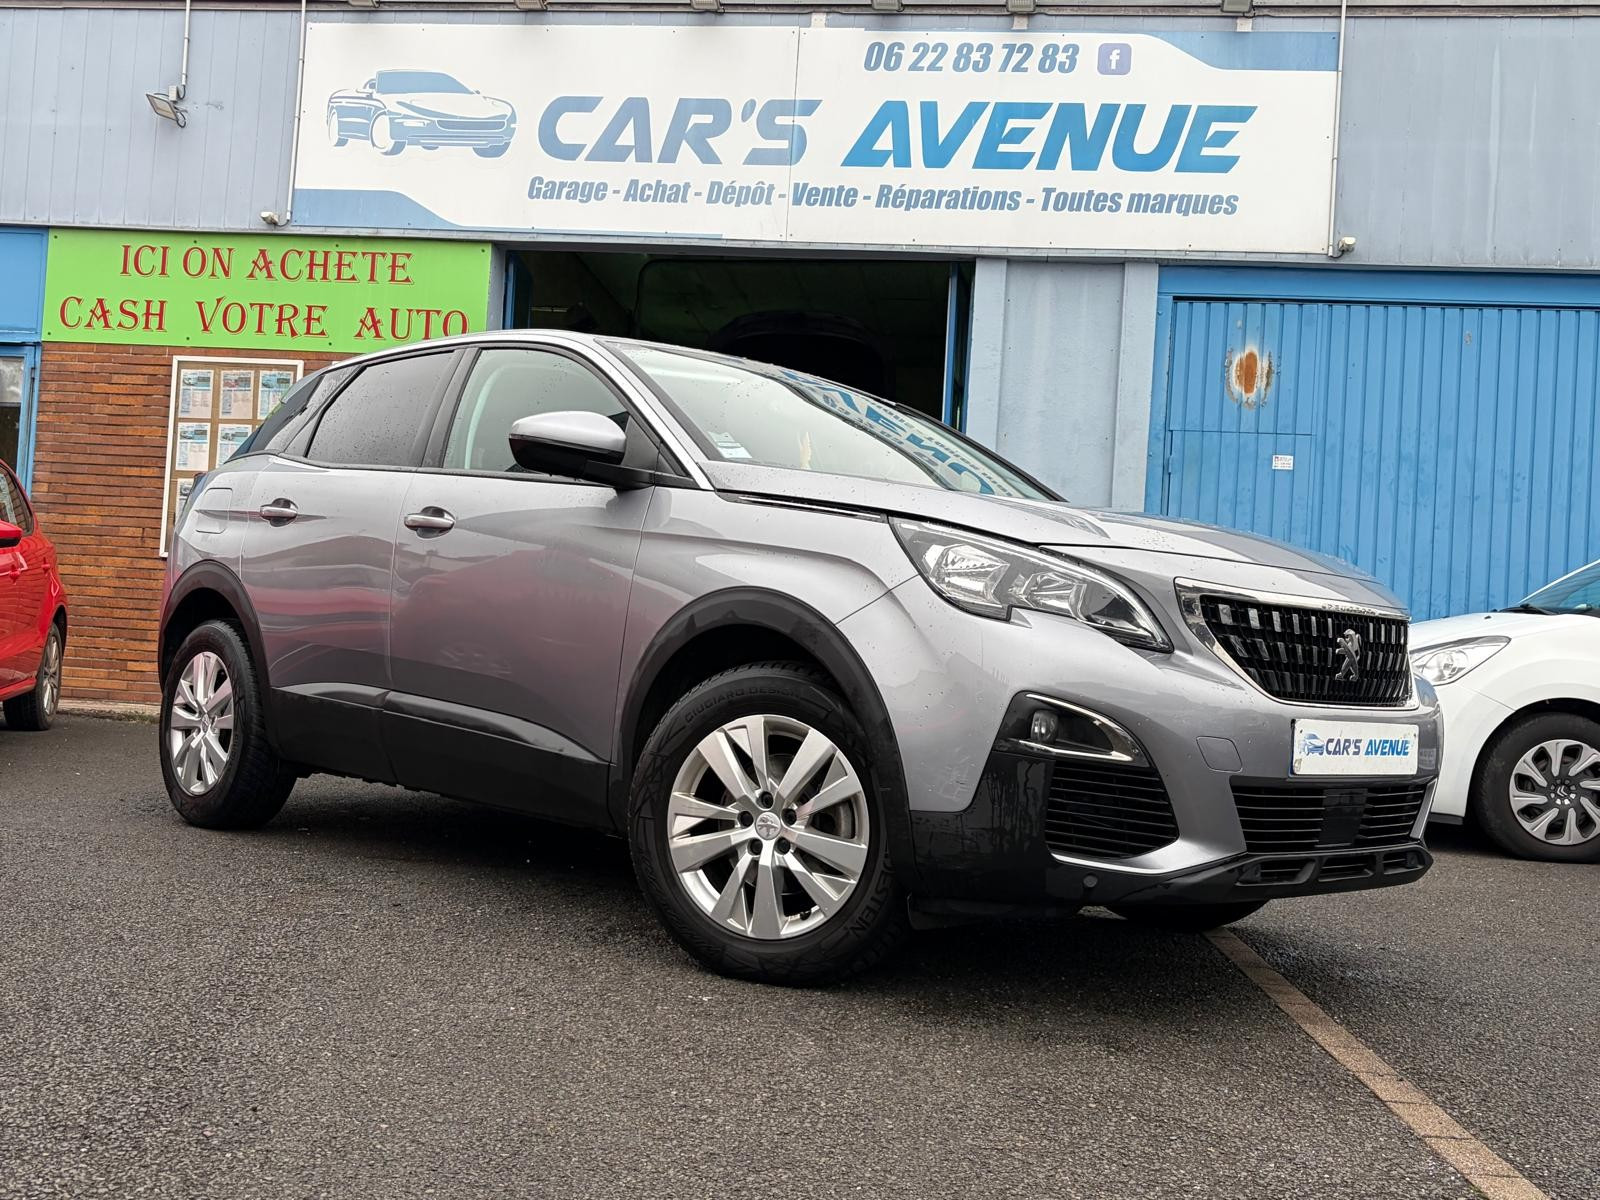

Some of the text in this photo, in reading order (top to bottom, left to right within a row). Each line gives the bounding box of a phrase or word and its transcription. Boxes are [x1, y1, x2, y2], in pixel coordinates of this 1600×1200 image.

[863, 41, 1079, 74] 06 22 83 72 83
[538, 95, 1258, 174] CAR'S AVENUE
[527, 175, 608, 203] Garage
[623, 179, 691, 203] Achat
[706, 180, 776, 207] Dépôt
[791, 182, 858, 208] Vente
[874, 184, 1021, 212] Réparations
[1040, 187, 1122, 213] Toutes
[1126, 190, 1240, 217] marques
[120, 244, 414, 285] ICI ON ACHETE
[59, 296, 470, 341] CASH VOTRE AUTO
[1325, 738, 1411, 757] CAR'S AVENUE
